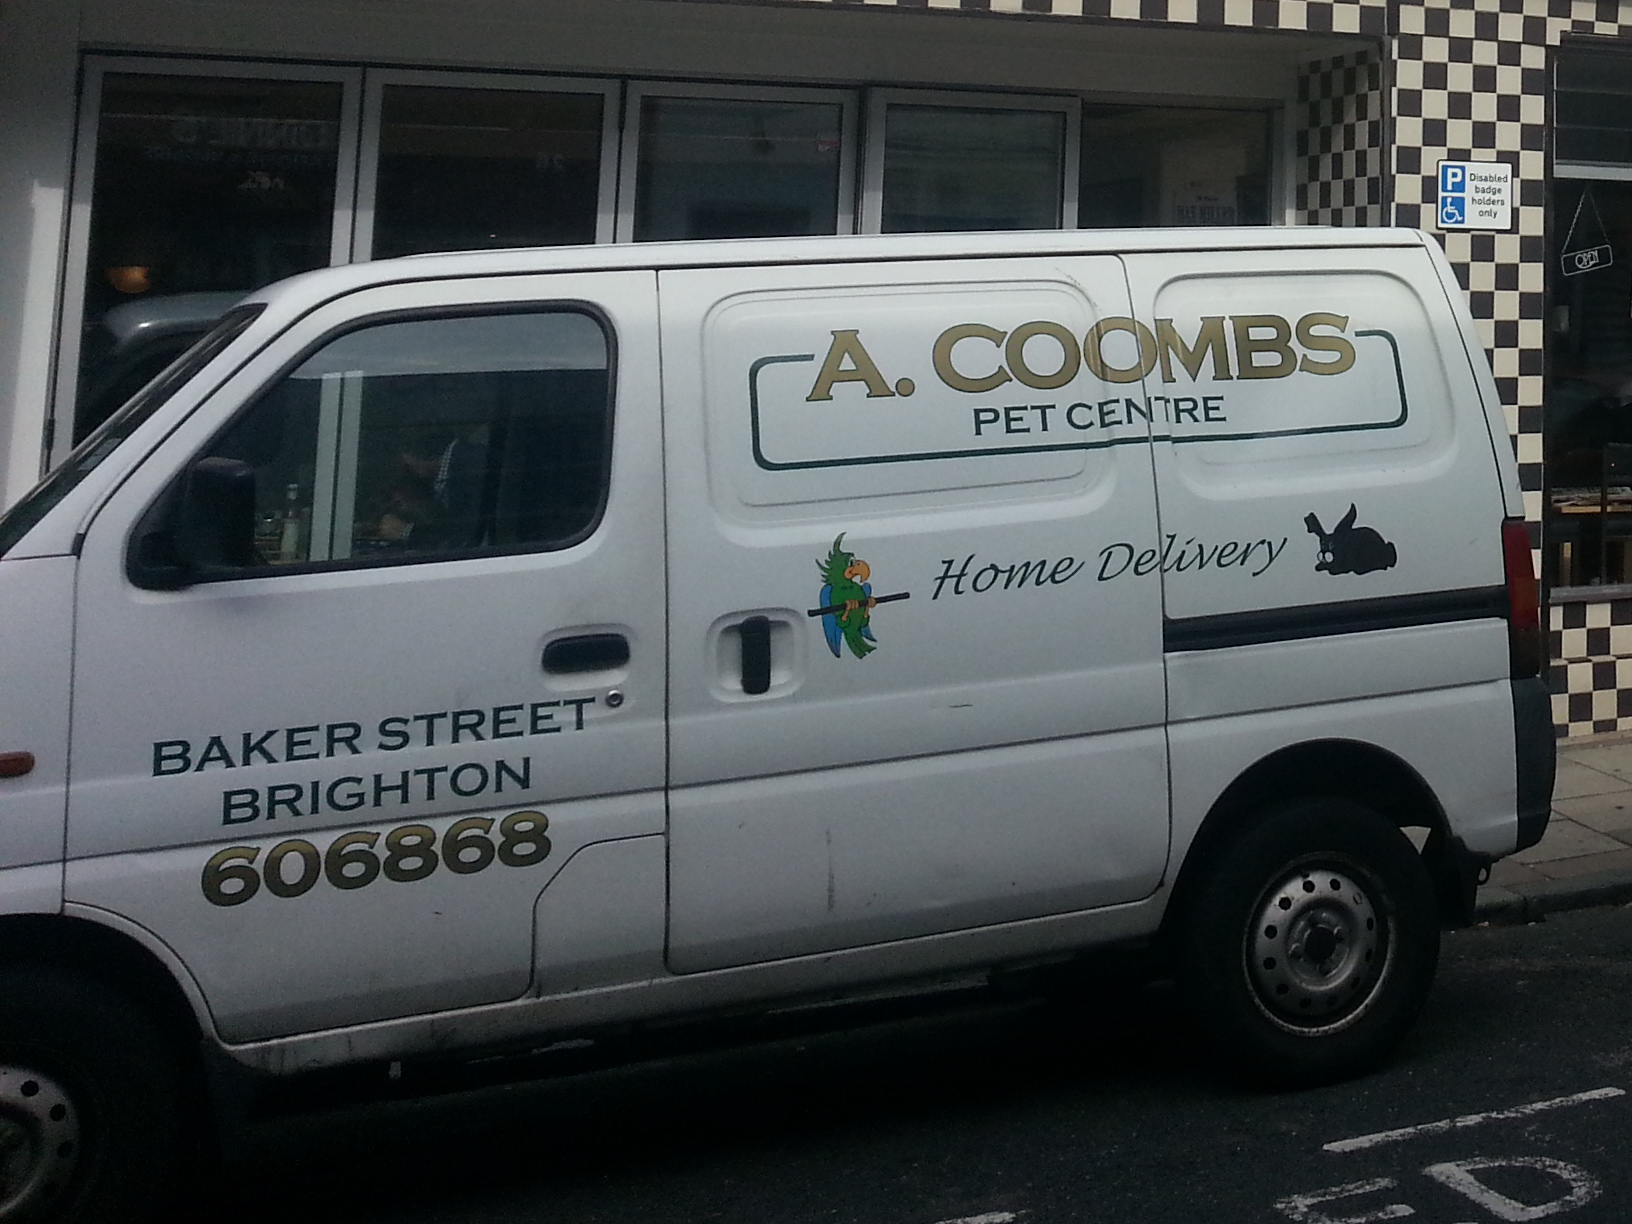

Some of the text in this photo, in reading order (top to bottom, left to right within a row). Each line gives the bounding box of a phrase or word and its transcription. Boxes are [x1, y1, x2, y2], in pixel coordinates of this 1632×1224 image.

[1447, 168, 1462, 190] P
[1469, 173, 1508, 183] Disabled
[1475, 185, 1502, 195] badge
[1471, 197, 1505, 206] holders
[1478, 209, 1498, 218] only
[806, 312, 1356, 402] A. COOMBS
[973, 394, 1227, 436] PET CENTRE
[933, 530, 1287, 601] Home Delivery
[152, 697, 597, 777] BAKER STREET
[222, 756, 532, 826] BRIGHTON
[200, 811, 551, 907] 606868
